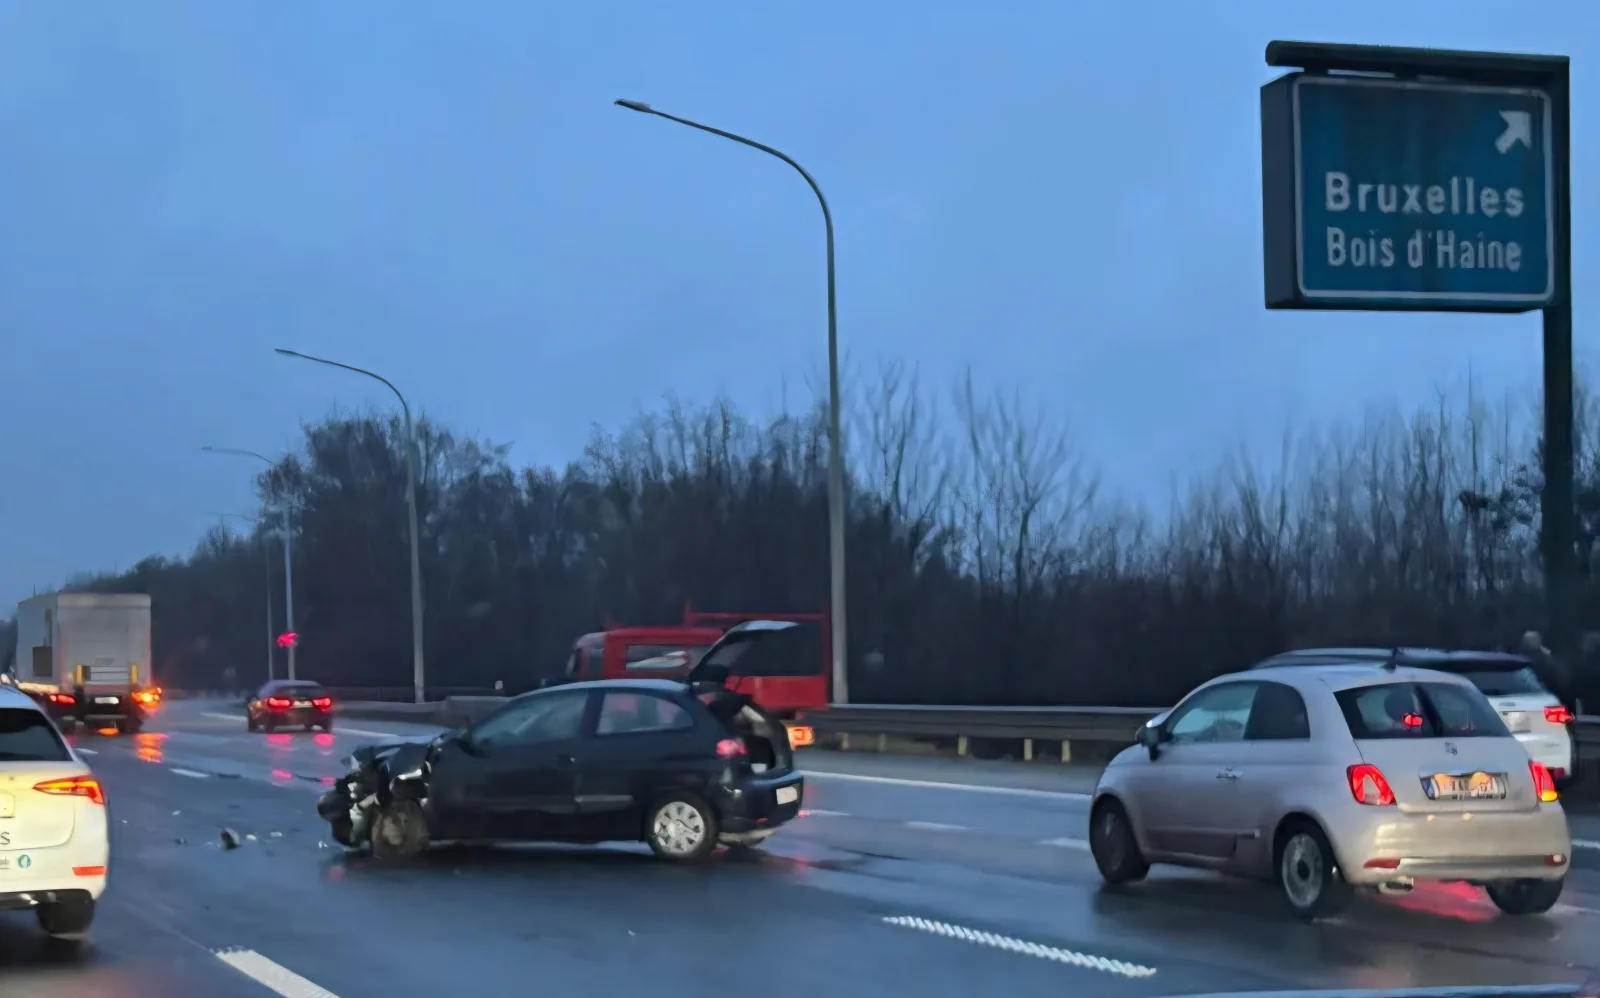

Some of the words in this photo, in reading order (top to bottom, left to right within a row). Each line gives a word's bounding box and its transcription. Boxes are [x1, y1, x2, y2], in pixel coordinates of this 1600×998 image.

[1325, 171, 1524, 218] Bruxelles
[1326, 226, 1395, 268] Bois
[1407, 228, 1522, 272] d'Haine
